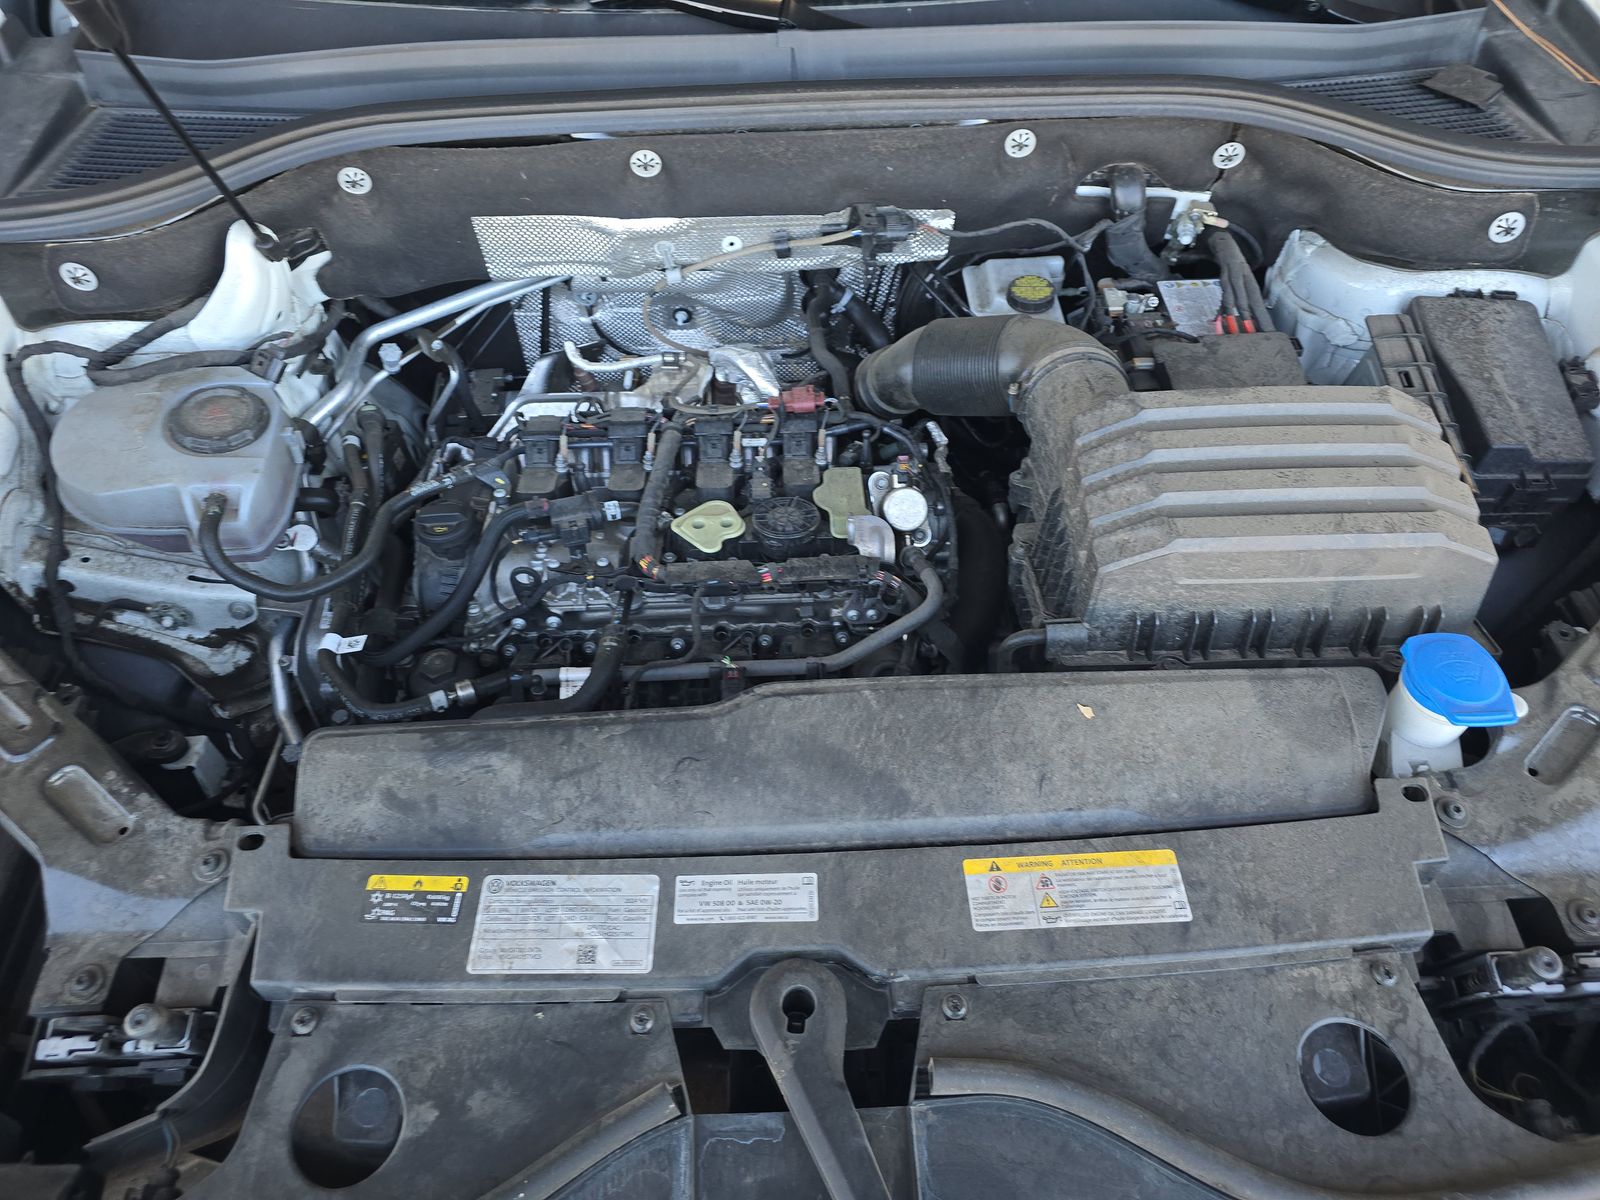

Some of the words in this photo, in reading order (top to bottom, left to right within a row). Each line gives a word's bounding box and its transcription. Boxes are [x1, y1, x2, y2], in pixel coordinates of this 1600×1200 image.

[1017, 860, 1053, 868] WARNING
[1061, 858, 1103, 866] ATTENTION
[506, 879, 557, 887] VOLKSWAGEN
